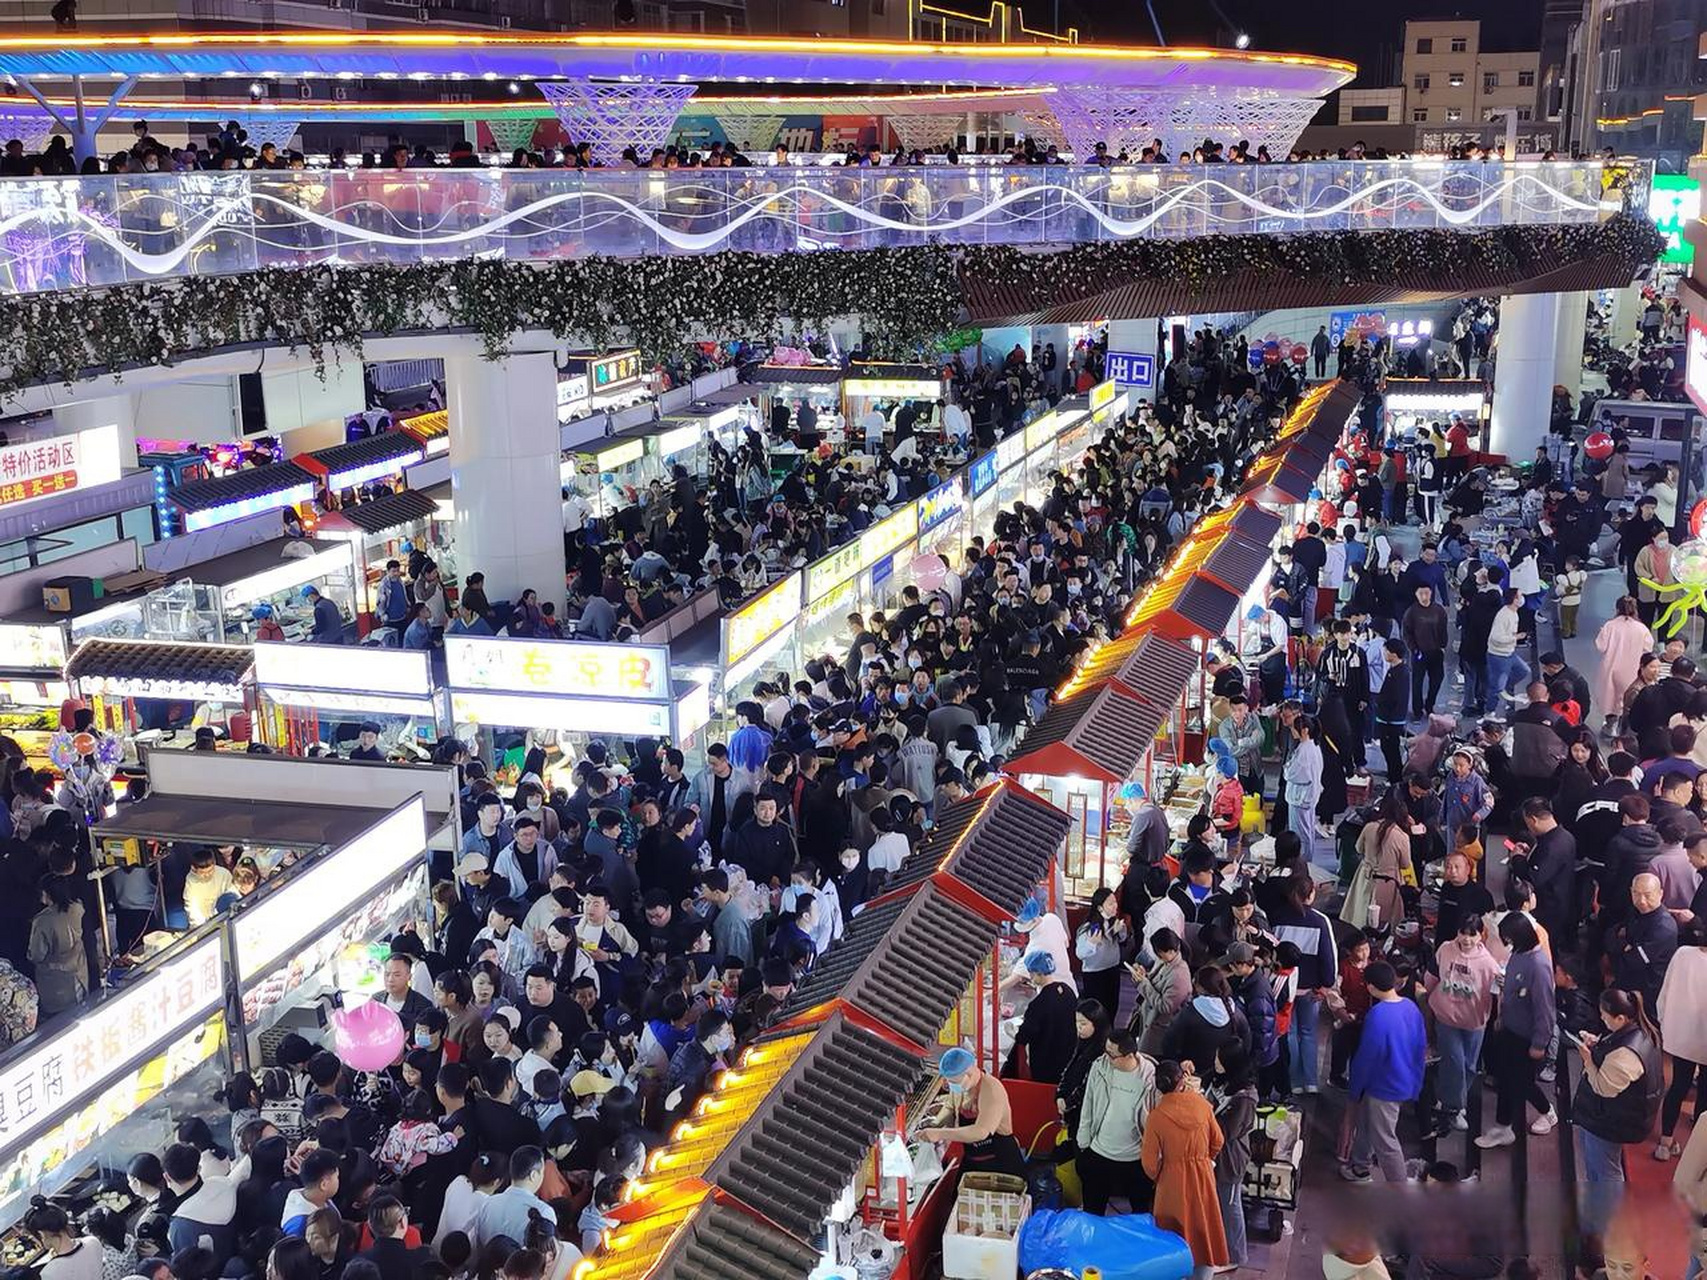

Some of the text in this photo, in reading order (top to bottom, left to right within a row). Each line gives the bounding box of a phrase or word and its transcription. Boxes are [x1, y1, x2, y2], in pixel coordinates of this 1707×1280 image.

[1110, 357, 1149, 382] 出口
[2, 441, 76, 479] 特价活动区
